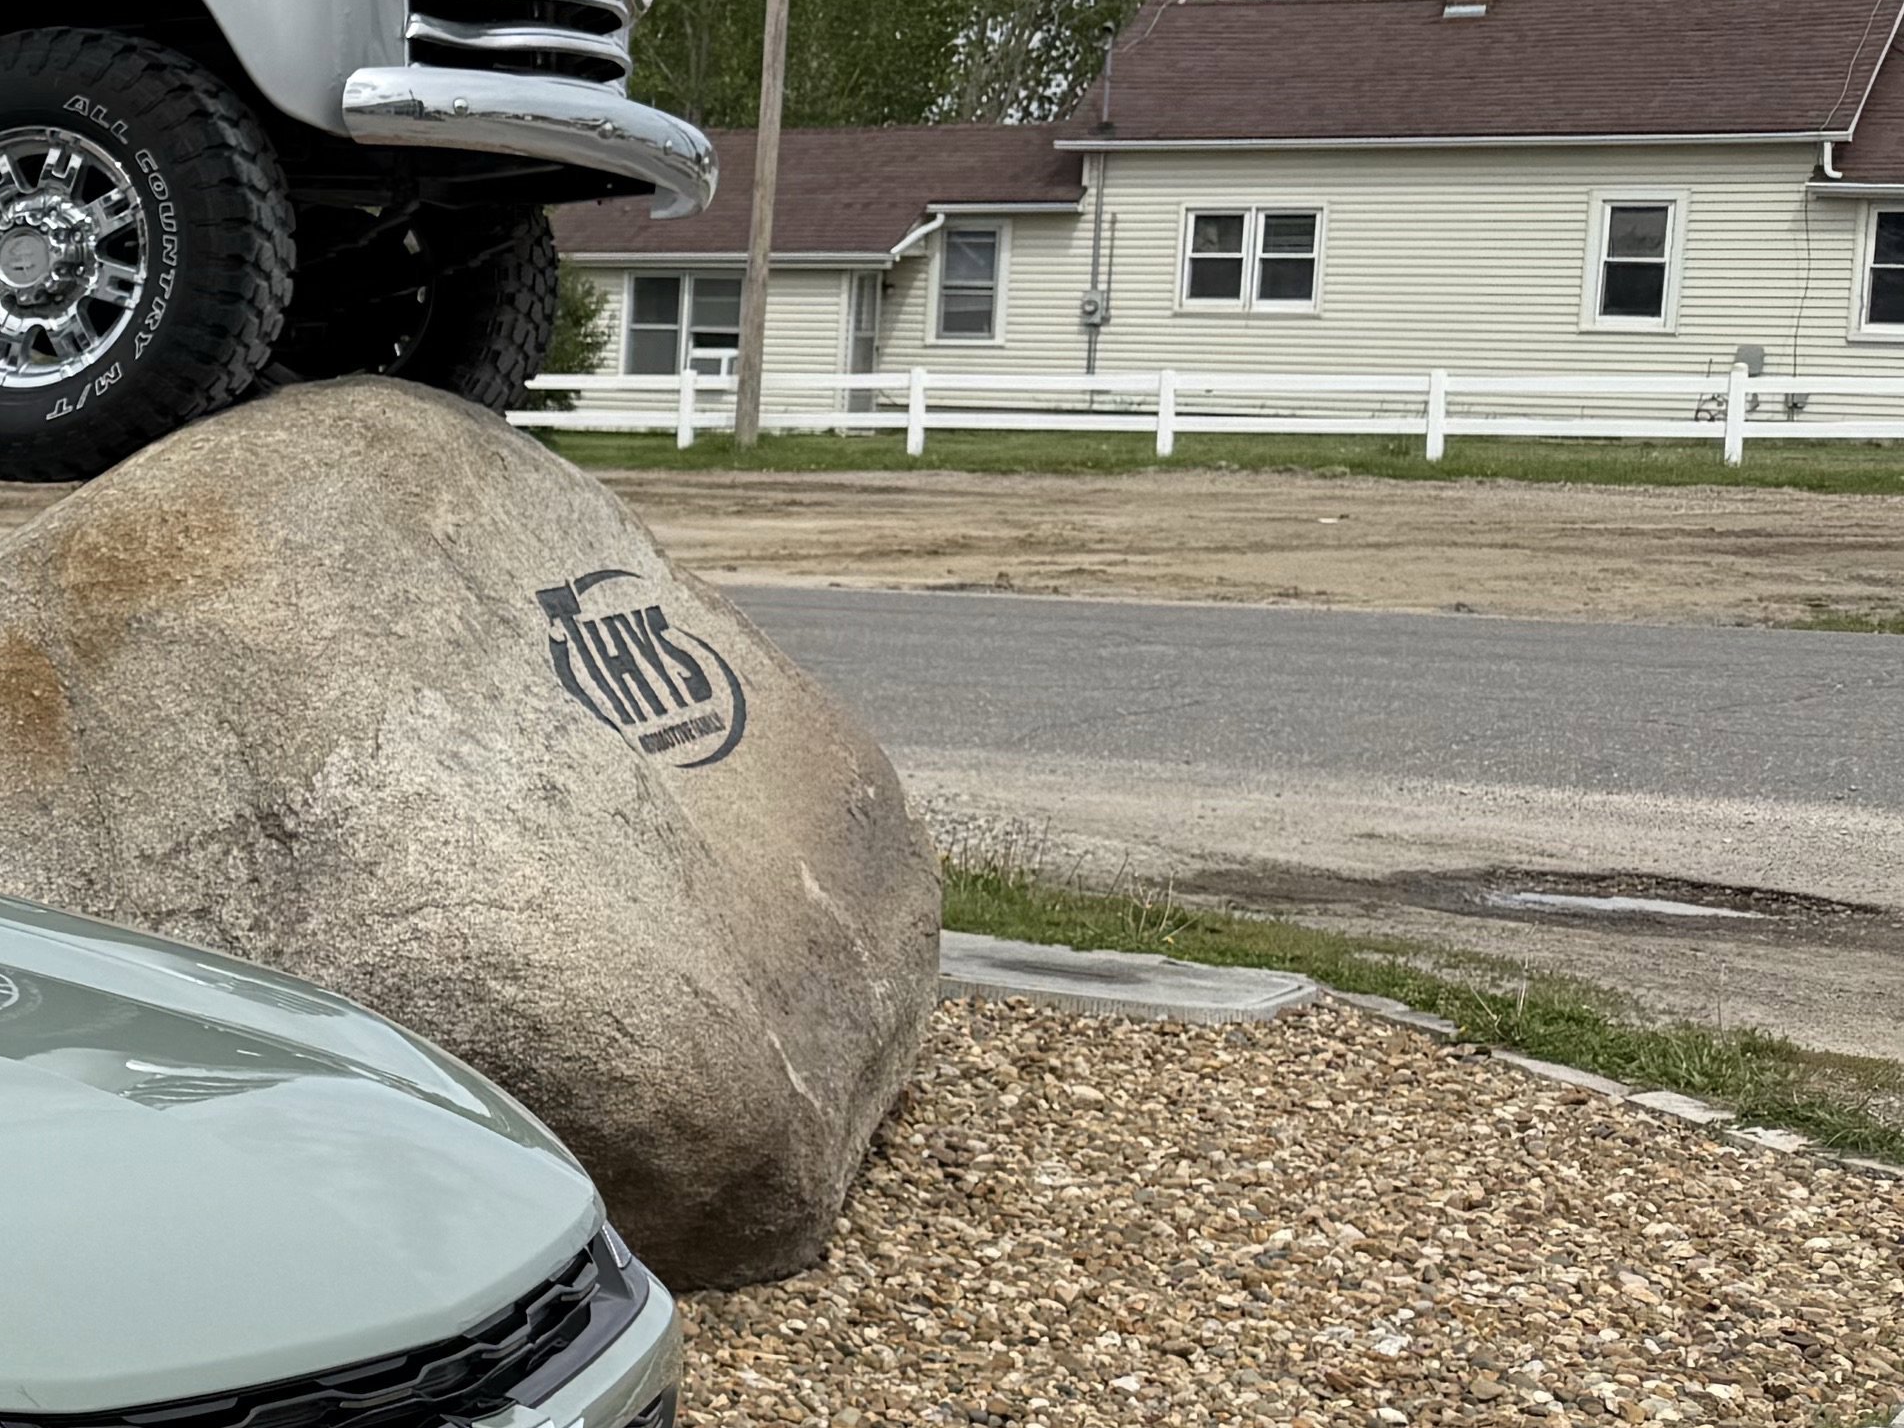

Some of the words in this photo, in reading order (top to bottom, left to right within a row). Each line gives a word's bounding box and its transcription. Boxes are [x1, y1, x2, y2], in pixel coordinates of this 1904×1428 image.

[63, 94, 129, 144] ALL
[134, 149, 179, 360] COUNTRY
[46, 362, 122, 421] M/T
[536, 579, 713, 724] THYS
